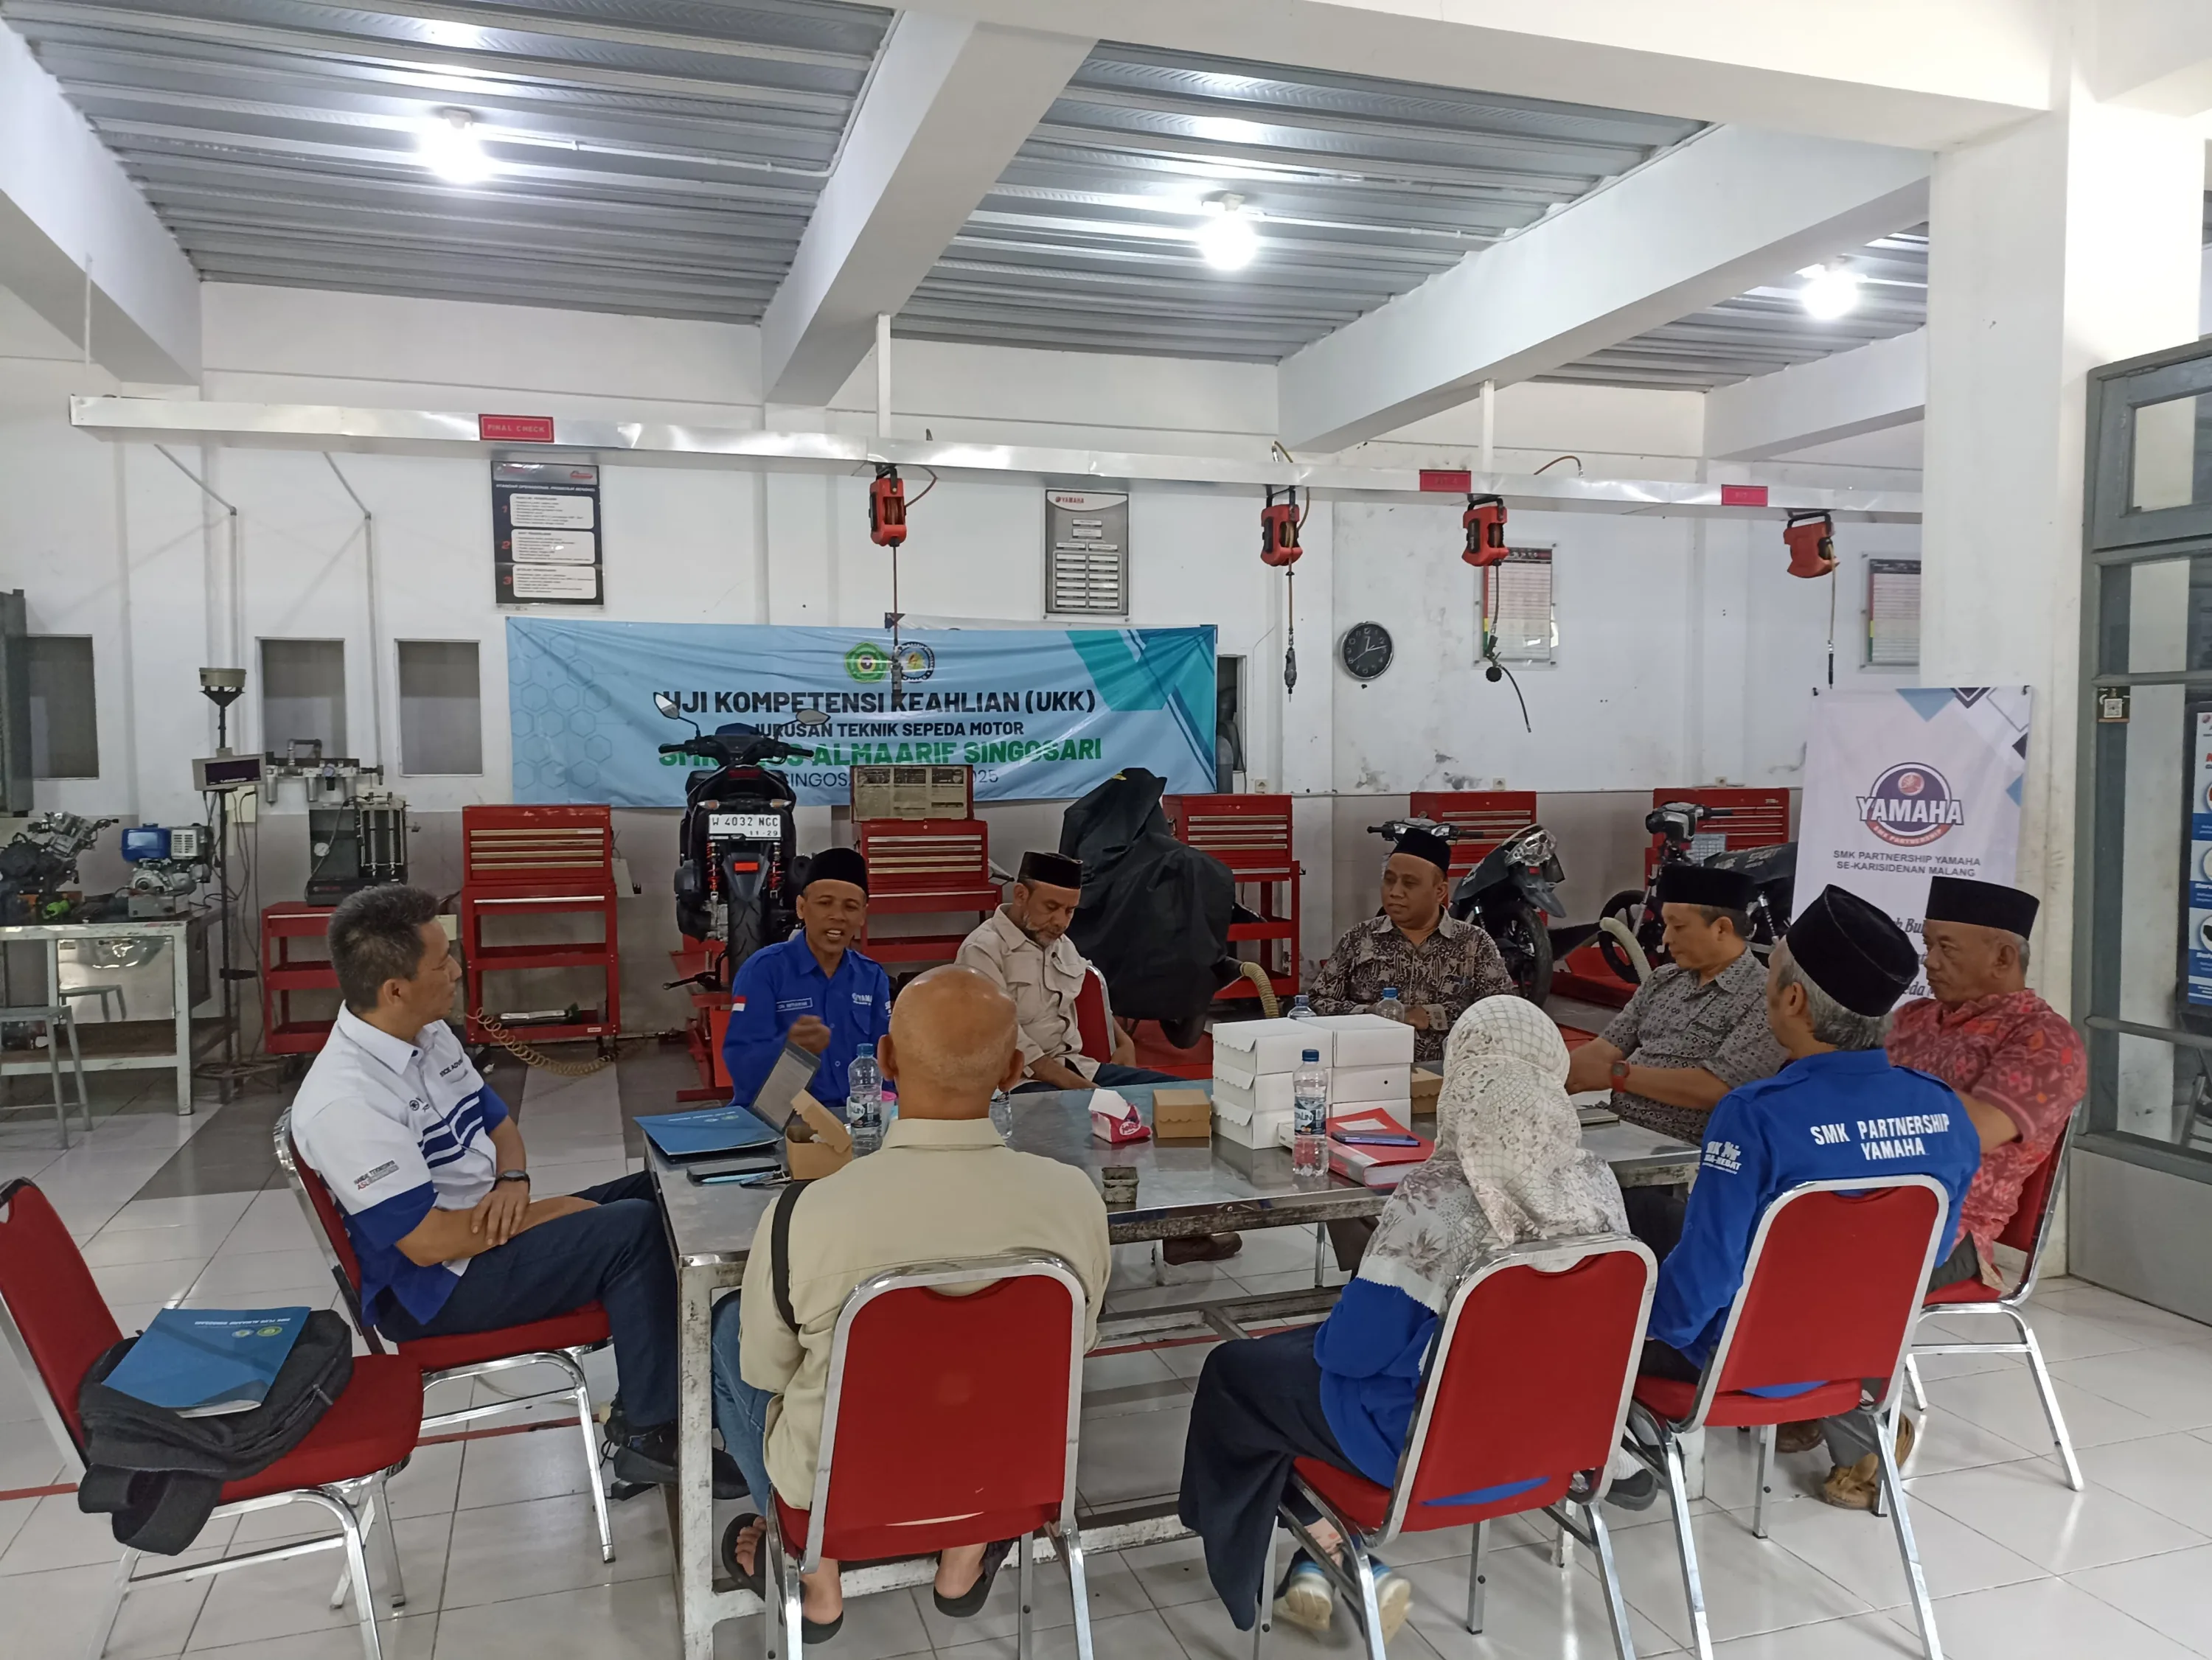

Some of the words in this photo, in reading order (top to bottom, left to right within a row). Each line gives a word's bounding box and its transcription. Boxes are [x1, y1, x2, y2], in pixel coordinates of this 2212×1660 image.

[714, 691, 884, 714] KOMPETENSI
[891, 691, 1019, 713] KEAHLIAN
[1026, 690, 1096, 714] (UKK)
[837, 723, 898, 737] TEKNIK
[902, 722, 965, 736] SEPEDA
[970, 721, 1024, 736] MOTOR
[812, 742, 957, 766] ALMAARIF
[964, 738, 1102, 764] SINGOSARI
[712, 817, 720, 826] W
[724, 816, 753, 826] 4032
[758, 817, 779, 826] NGC
[1856, 795, 1965, 826] YAMAHA
[1833, 850, 1856, 859] SMK
[1858, 851, 1933, 862] PARTNERSHIP
[1935, 855, 1981, 866] YAMAHA
[1836, 860, 1926, 874] SE-KARISIDENAN
[1929, 865, 1976, 877] MALANG
[1810, 1123, 1851, 1145] SMK
[1857, 1113, 1950, 1140] PARTNERSHIP
[1860, 1137, 1927, 1161] YAMAHA
